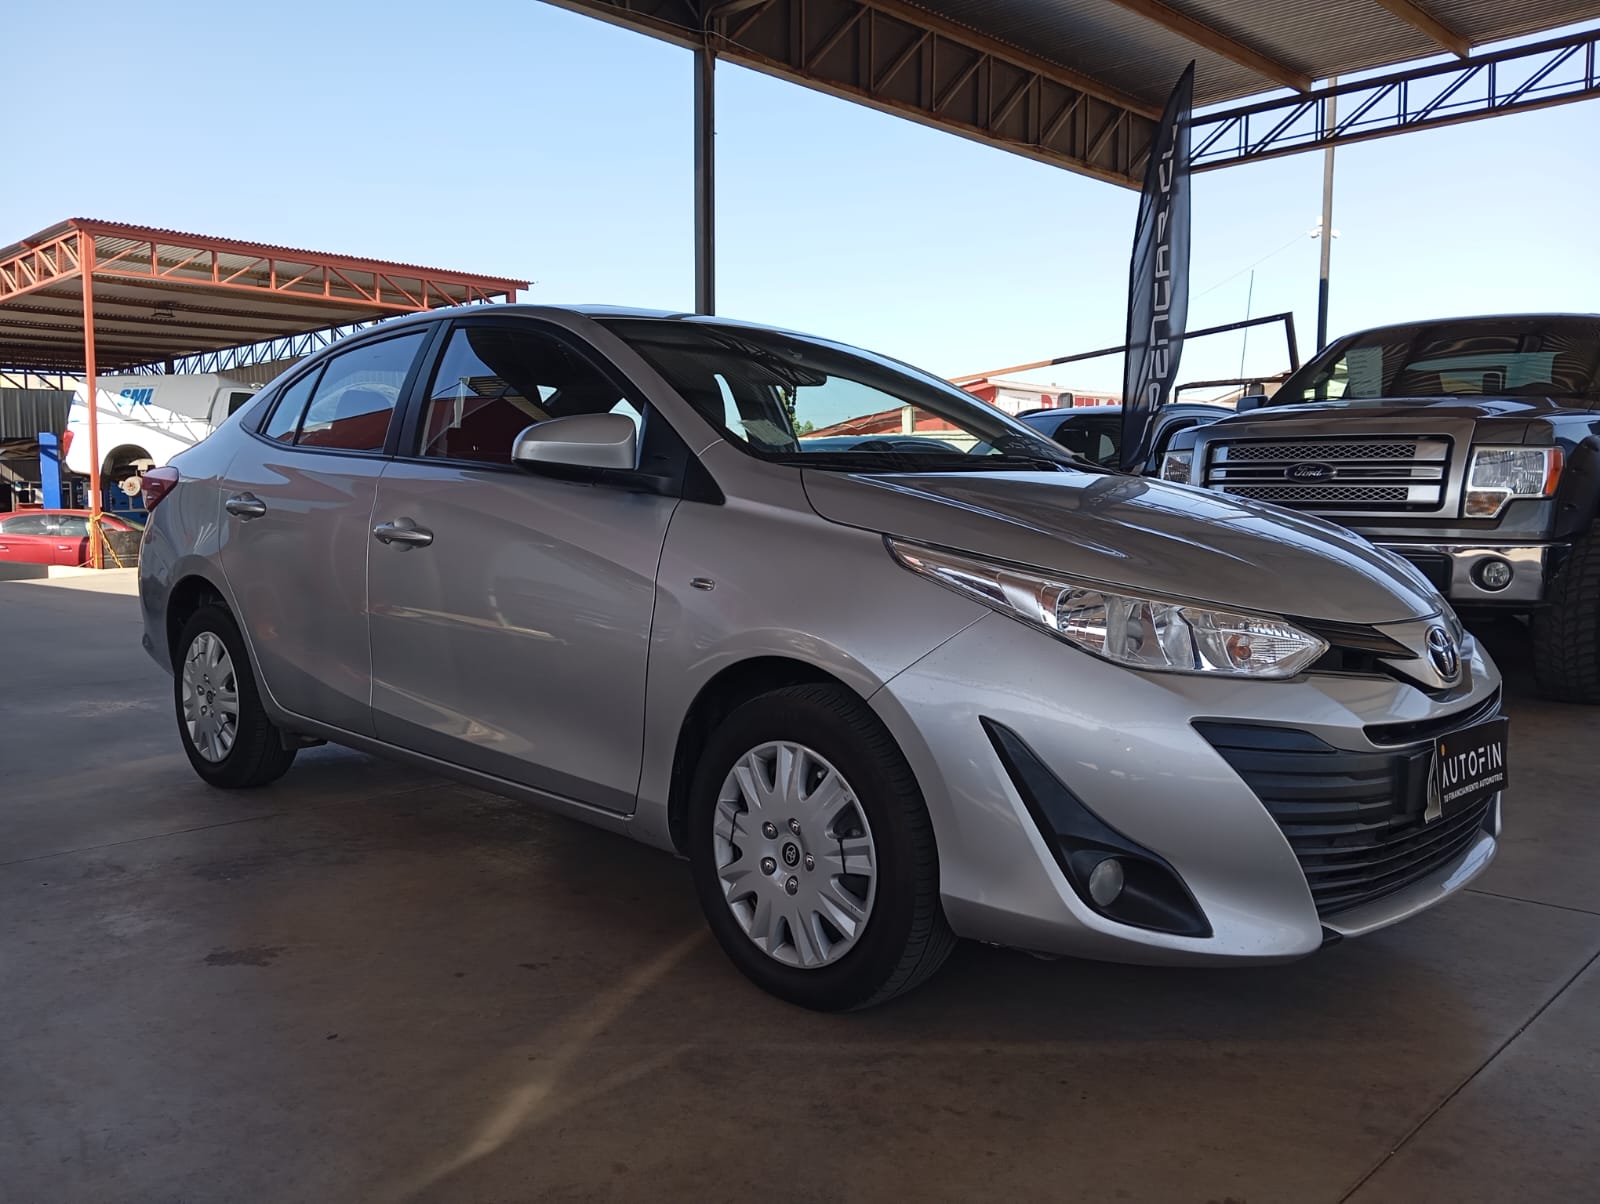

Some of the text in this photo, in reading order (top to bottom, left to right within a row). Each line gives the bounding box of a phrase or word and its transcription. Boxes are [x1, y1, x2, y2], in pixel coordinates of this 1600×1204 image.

[118, 388, 154, 406] SML
[1294, 465, 1322, 477] Ford
[1442, 741, 1502, 789] AUTOFIN
